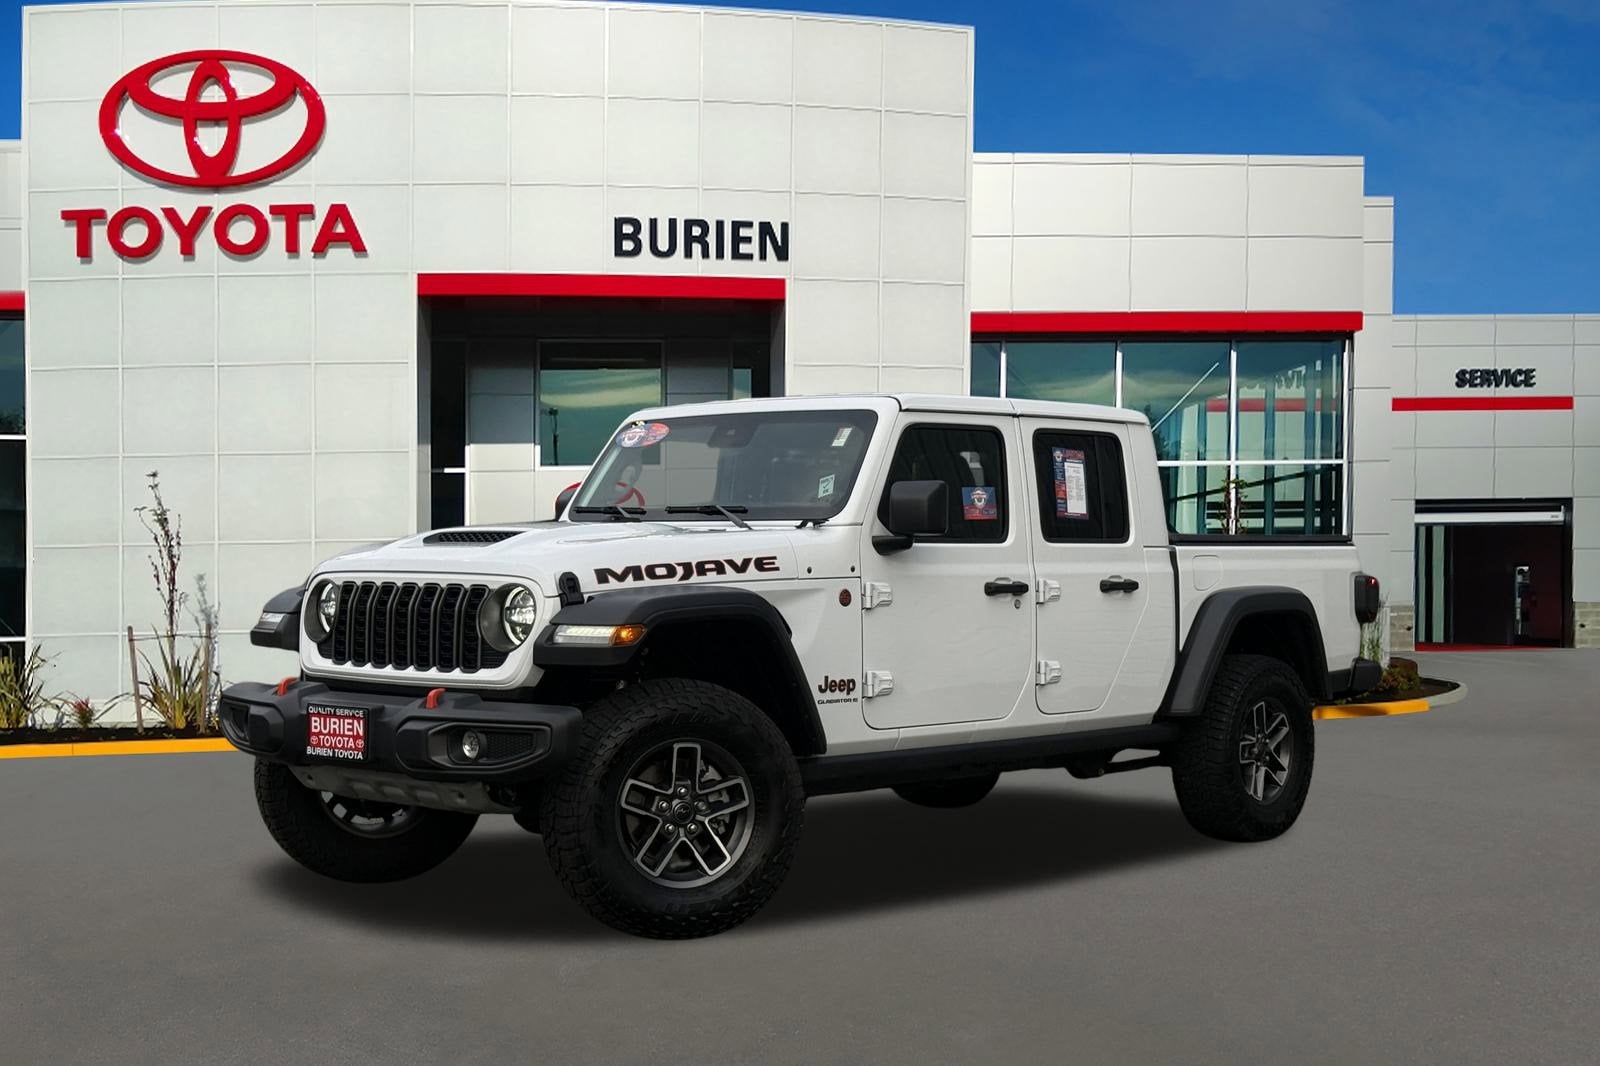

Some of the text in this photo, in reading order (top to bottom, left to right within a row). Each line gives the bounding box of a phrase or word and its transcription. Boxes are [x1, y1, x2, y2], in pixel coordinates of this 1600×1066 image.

[61, 203, 368, 259] TOYOTA
[614, 216, 789, 261] BURIEN
[1455, 368, 1536, 388] SERVICE
[593, 556, 780, 584] MOJAVE
[818, 675, 856, 695] Jeep
[308, 706, 364, 717] QUALITY SERVICE
[311, 716, 364, 736] BURIEN
[319, 735, 355, 748] TOYOTA
[306, 746, 363, 760] BURIEN TOYOTA
